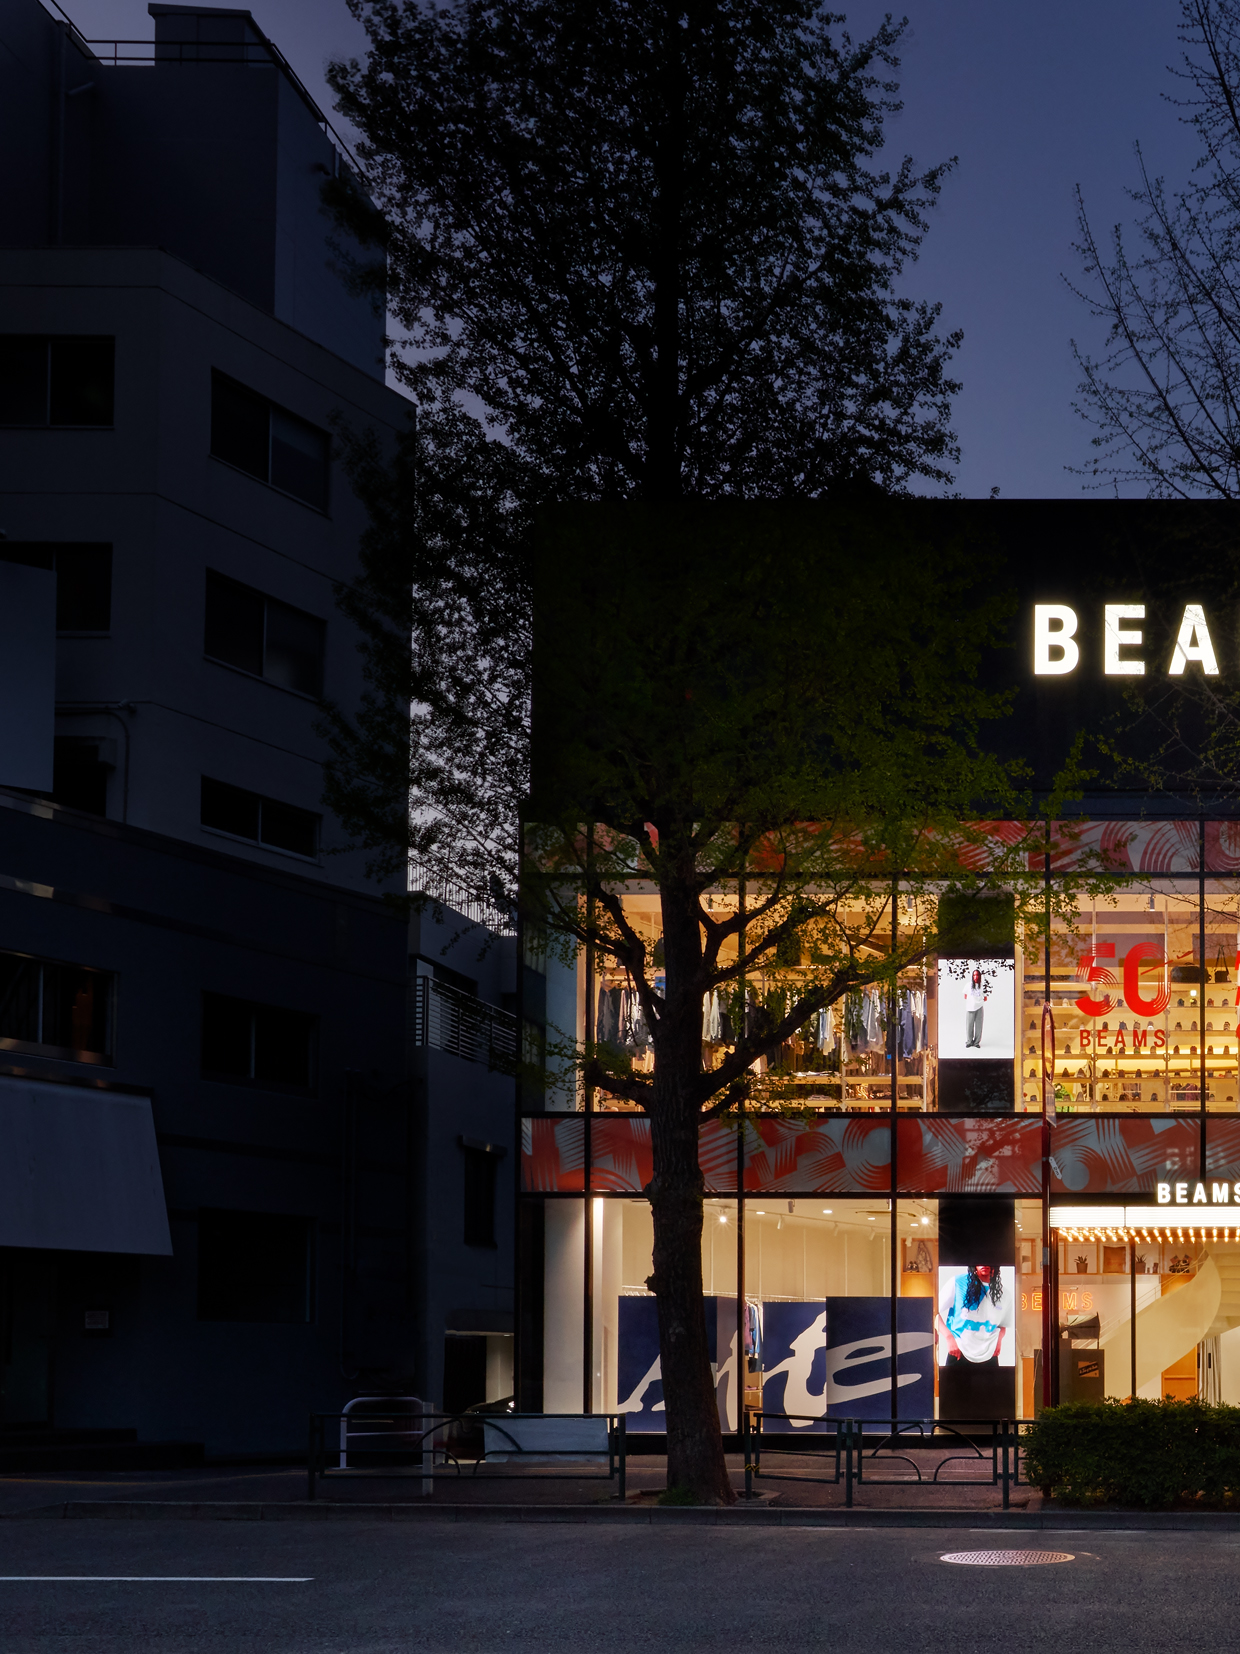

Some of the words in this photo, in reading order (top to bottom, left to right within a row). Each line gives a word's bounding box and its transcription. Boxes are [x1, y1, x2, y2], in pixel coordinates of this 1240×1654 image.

[1075, 942, 1171, 1017] 50
[1080, 1029, 1166, 1047] BEAMS
[1021, 1292, 1093, 1311] BEMS
